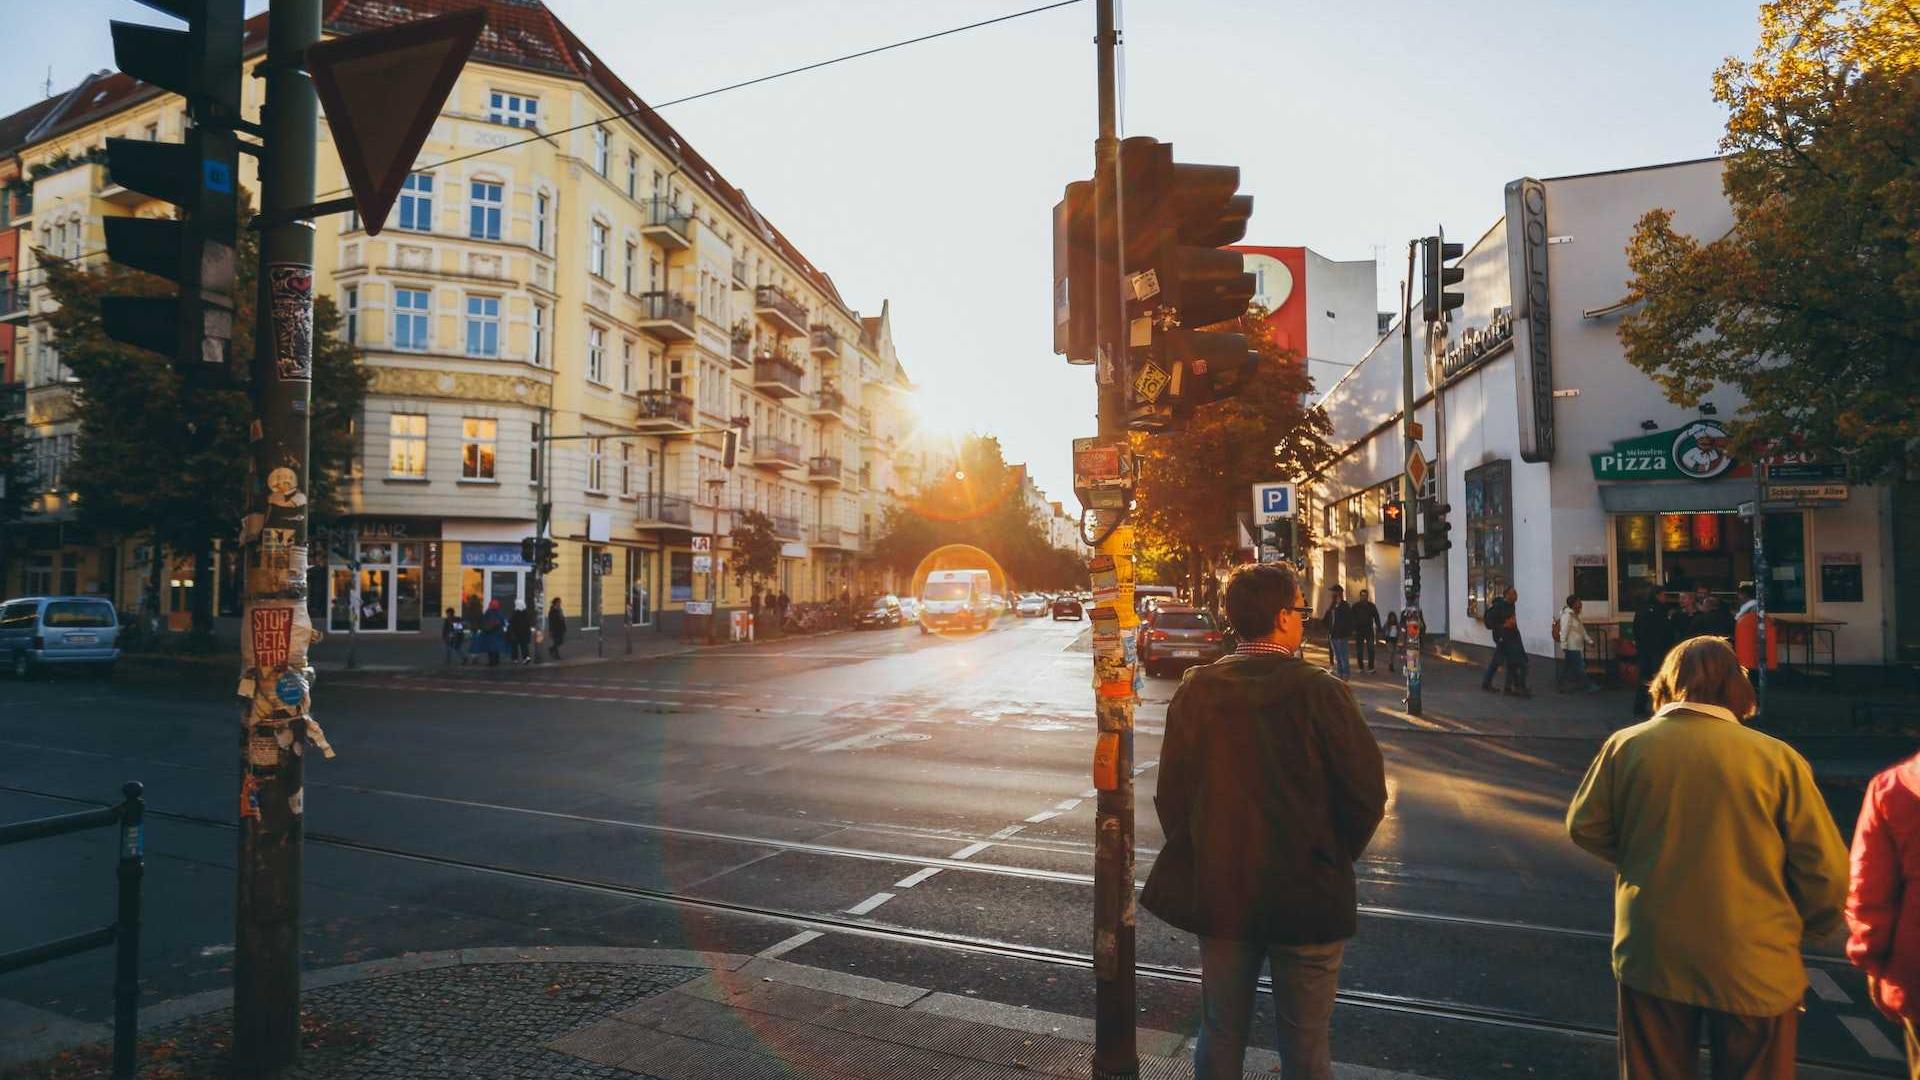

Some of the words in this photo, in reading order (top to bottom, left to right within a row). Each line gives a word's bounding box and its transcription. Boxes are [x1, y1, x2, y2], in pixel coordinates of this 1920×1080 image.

[1525, 187, 1552, 450] COLOSSEUM
[1600, 452, 1667, 472] Pizza
[1268, 491, 1282, 510] P
[254, 610, 290, 630] STOP
